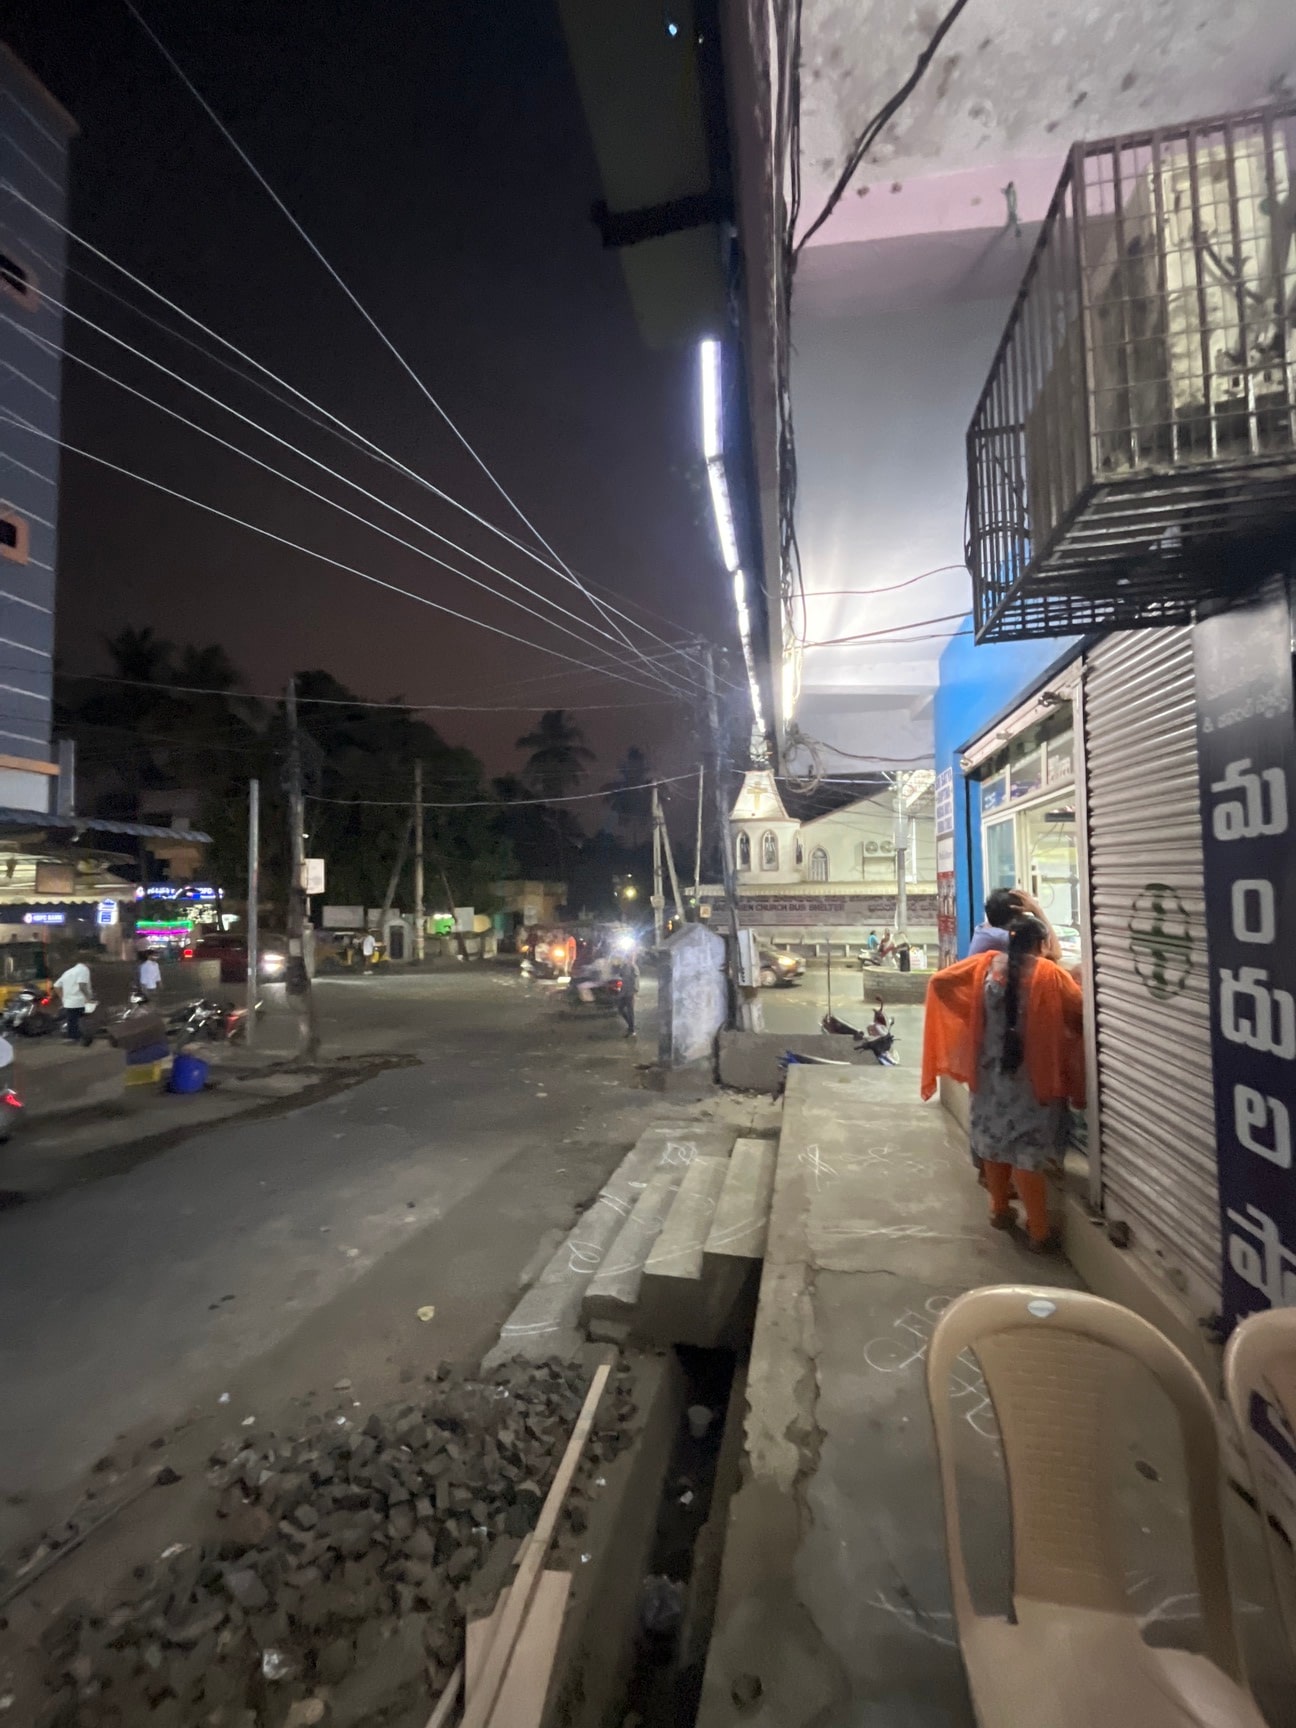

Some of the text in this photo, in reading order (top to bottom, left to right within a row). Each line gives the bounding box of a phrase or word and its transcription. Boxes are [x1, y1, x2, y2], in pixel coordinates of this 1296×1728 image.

[755, 903, 788, 912] CHURCH
[789, 903, 807, 912] BUS
[808, 903, 846, 912] SHELTER
